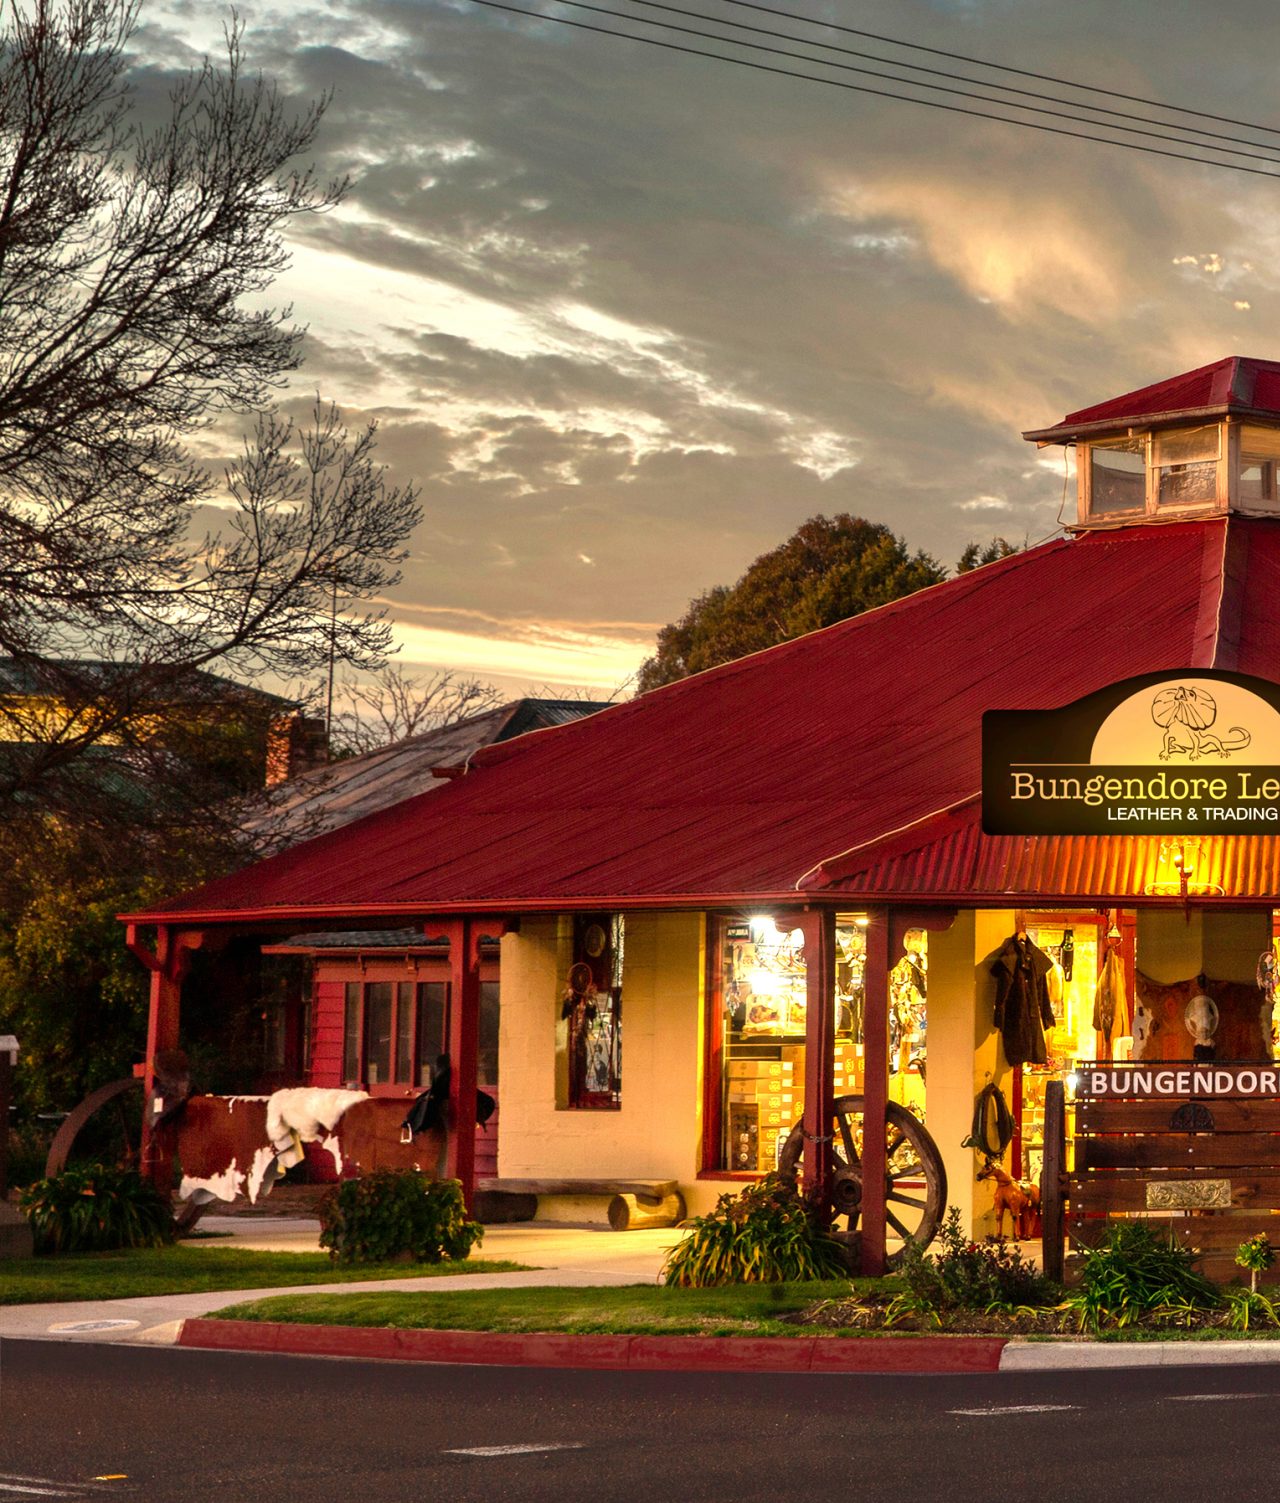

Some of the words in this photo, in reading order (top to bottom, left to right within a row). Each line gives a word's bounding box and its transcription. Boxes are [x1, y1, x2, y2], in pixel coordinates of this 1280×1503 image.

[1010, 772, 1227, 806] Bungendore
[1107, 807, 1182, 821] LEATHER
[1187, 807, 1199, 821] &
[1203, 807, 1279, 821] TRADING
